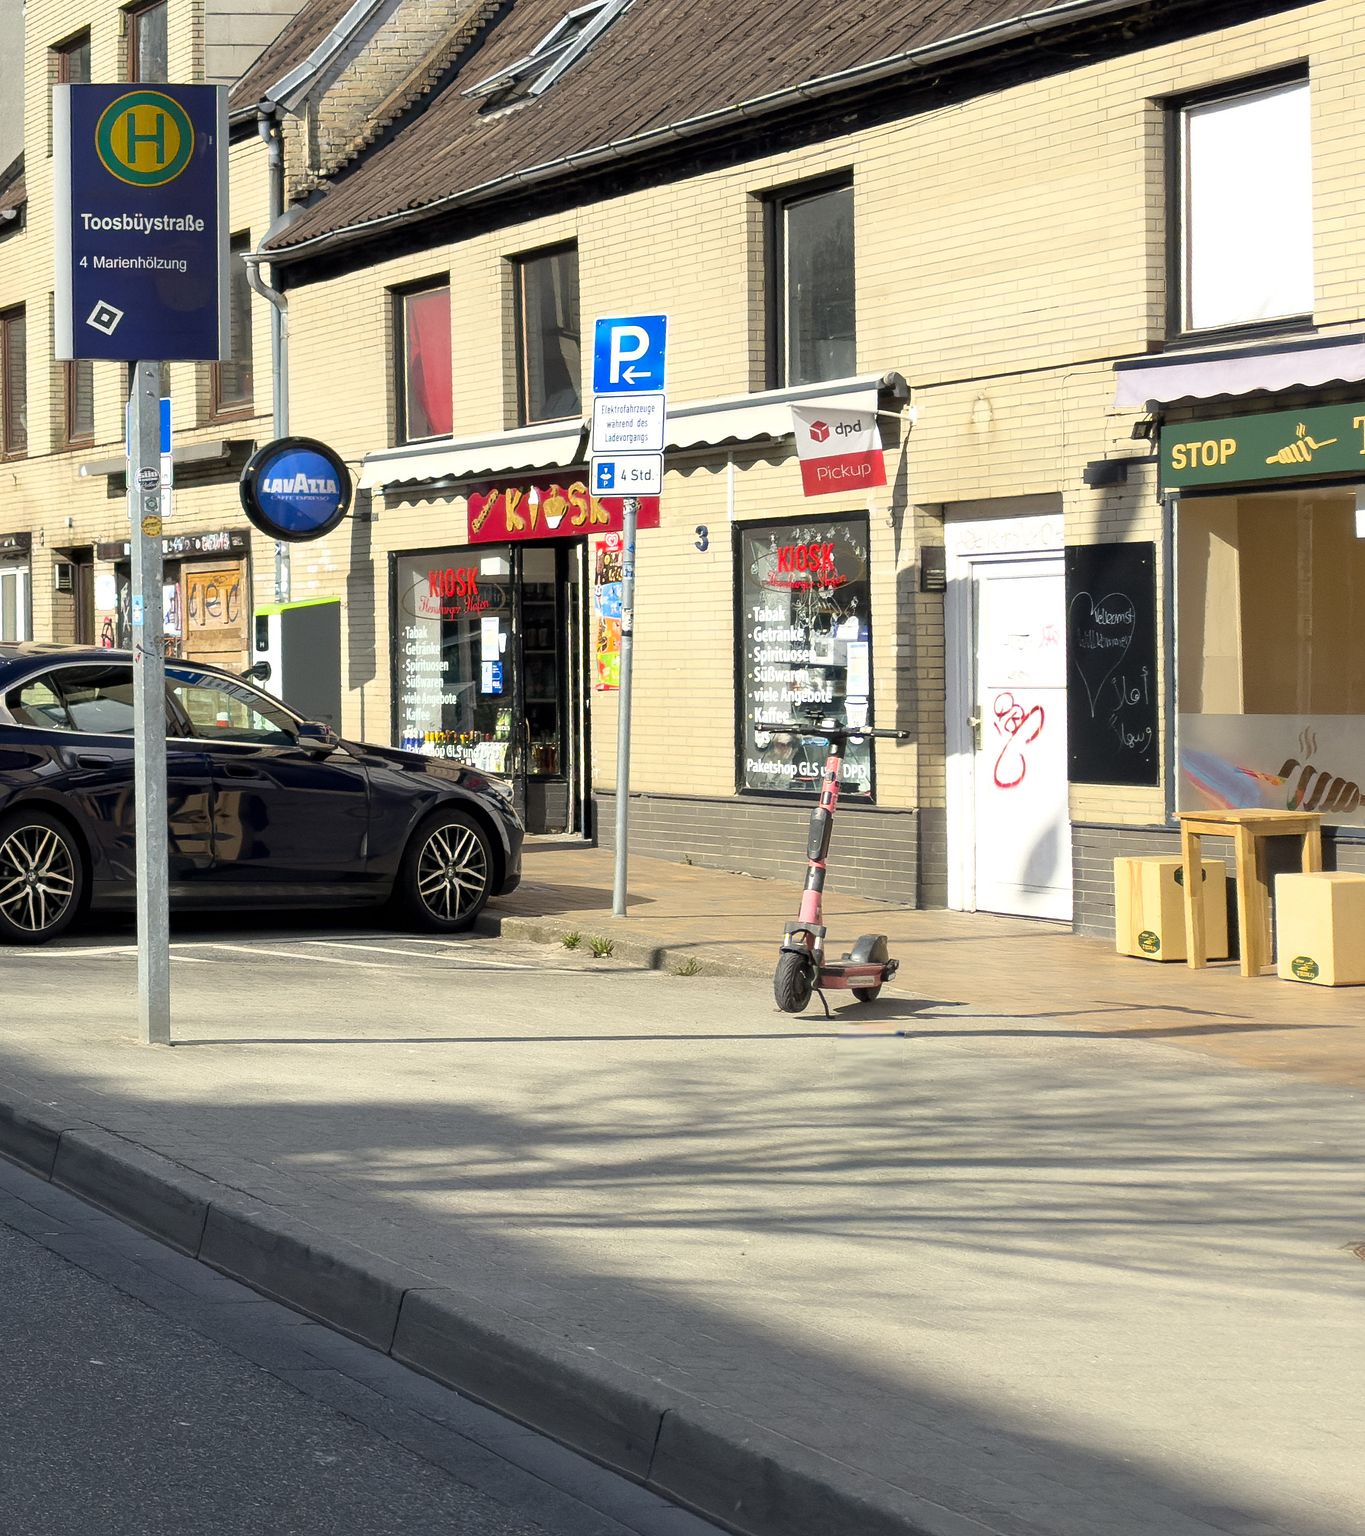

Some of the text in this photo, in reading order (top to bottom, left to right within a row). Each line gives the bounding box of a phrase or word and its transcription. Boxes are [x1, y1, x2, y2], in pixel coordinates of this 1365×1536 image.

[127, 112, 165, 164] H
[81, 214, 205, 235] Toosbüystraße
[80, 256, 187, 272] 4 Marienhölzung
[610, 326, 650, 383] P
[601, 405, 655, 415] Elektrofahrzeuge
[606, 419, 648, 428] während des
[835, 419, 862, 437] dpd
[605, 433, 648, 443] Ladevorgangs
[1171, 438, 1237, 470] STOP
[621, 469, 655, 481] 4 Std.
[816, 463, 872, 481] Pickup
[262, 473, 337, 494] LAVAZZA
[695, 525, 709, 552] 3
[777, 543, 835, 573] KIOSK
[429, 567, 479, 597] KIOSK
[753, 605, 786, 622] Tabak
[405, 626, 428, 639] Tabak
[753, 625, 805, 642] Getränke
[405, 642, 441, 656] Getränke
[753, 647, 817, 666] Spirituosen
[405, 658, 449, 674] Spirituosen
[753, 665, 809, 683] Süßwaren
[405, 675, 444, 688] Süßwaren
[404, 691, 457, 708] viele Angebote
[753, 687, 833, 706] viele Angebote
[406, 707, 431, 721] Kaffee
[754, 707, 790, 724] Kaffee
[446, 744, 463, 758] GLS
[746, 758, 797, 780] Paketshop
[799, 761, 820, 777] GLS
[843, 763, 867, 779] DPD
